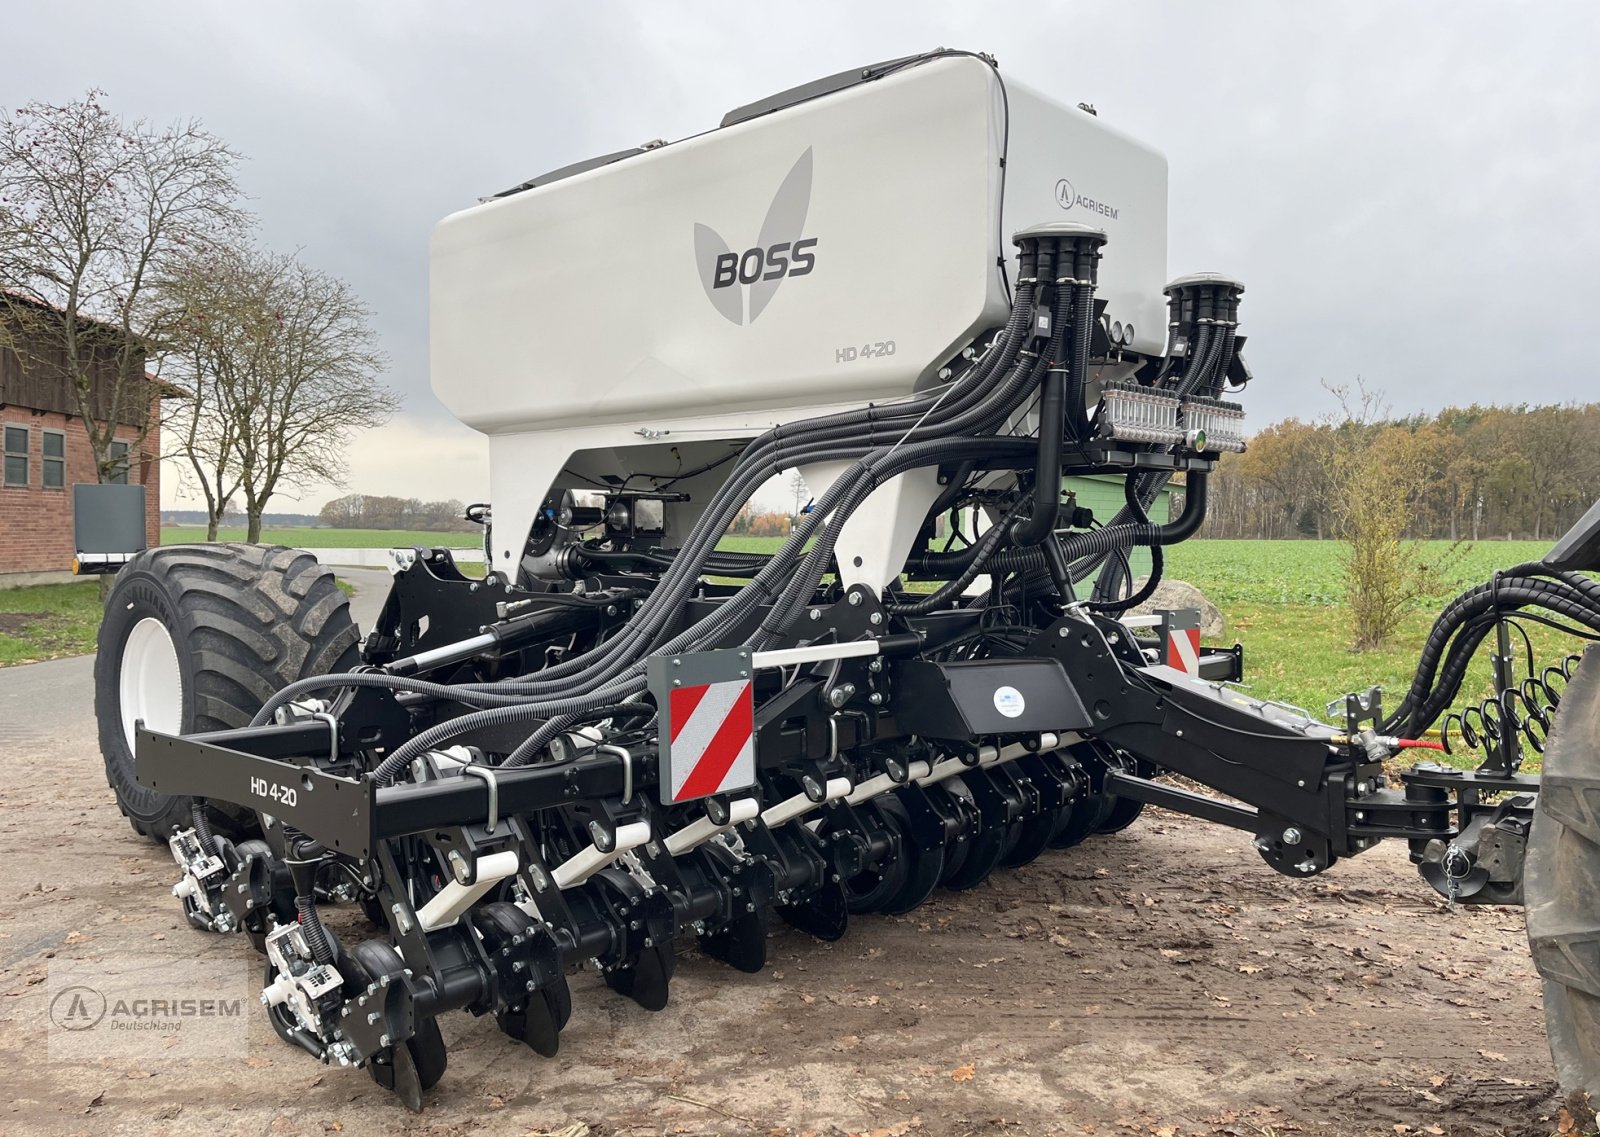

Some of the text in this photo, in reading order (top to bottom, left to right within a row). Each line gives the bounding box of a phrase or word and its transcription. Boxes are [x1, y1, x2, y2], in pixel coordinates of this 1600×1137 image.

[1075, 194, 1118, 220] AGRISEM
[713, 237, 818, 289] BOSS
[835, 340, 896, 363] HD 4-20
[250, 776, 297, 807] HD 4-20
